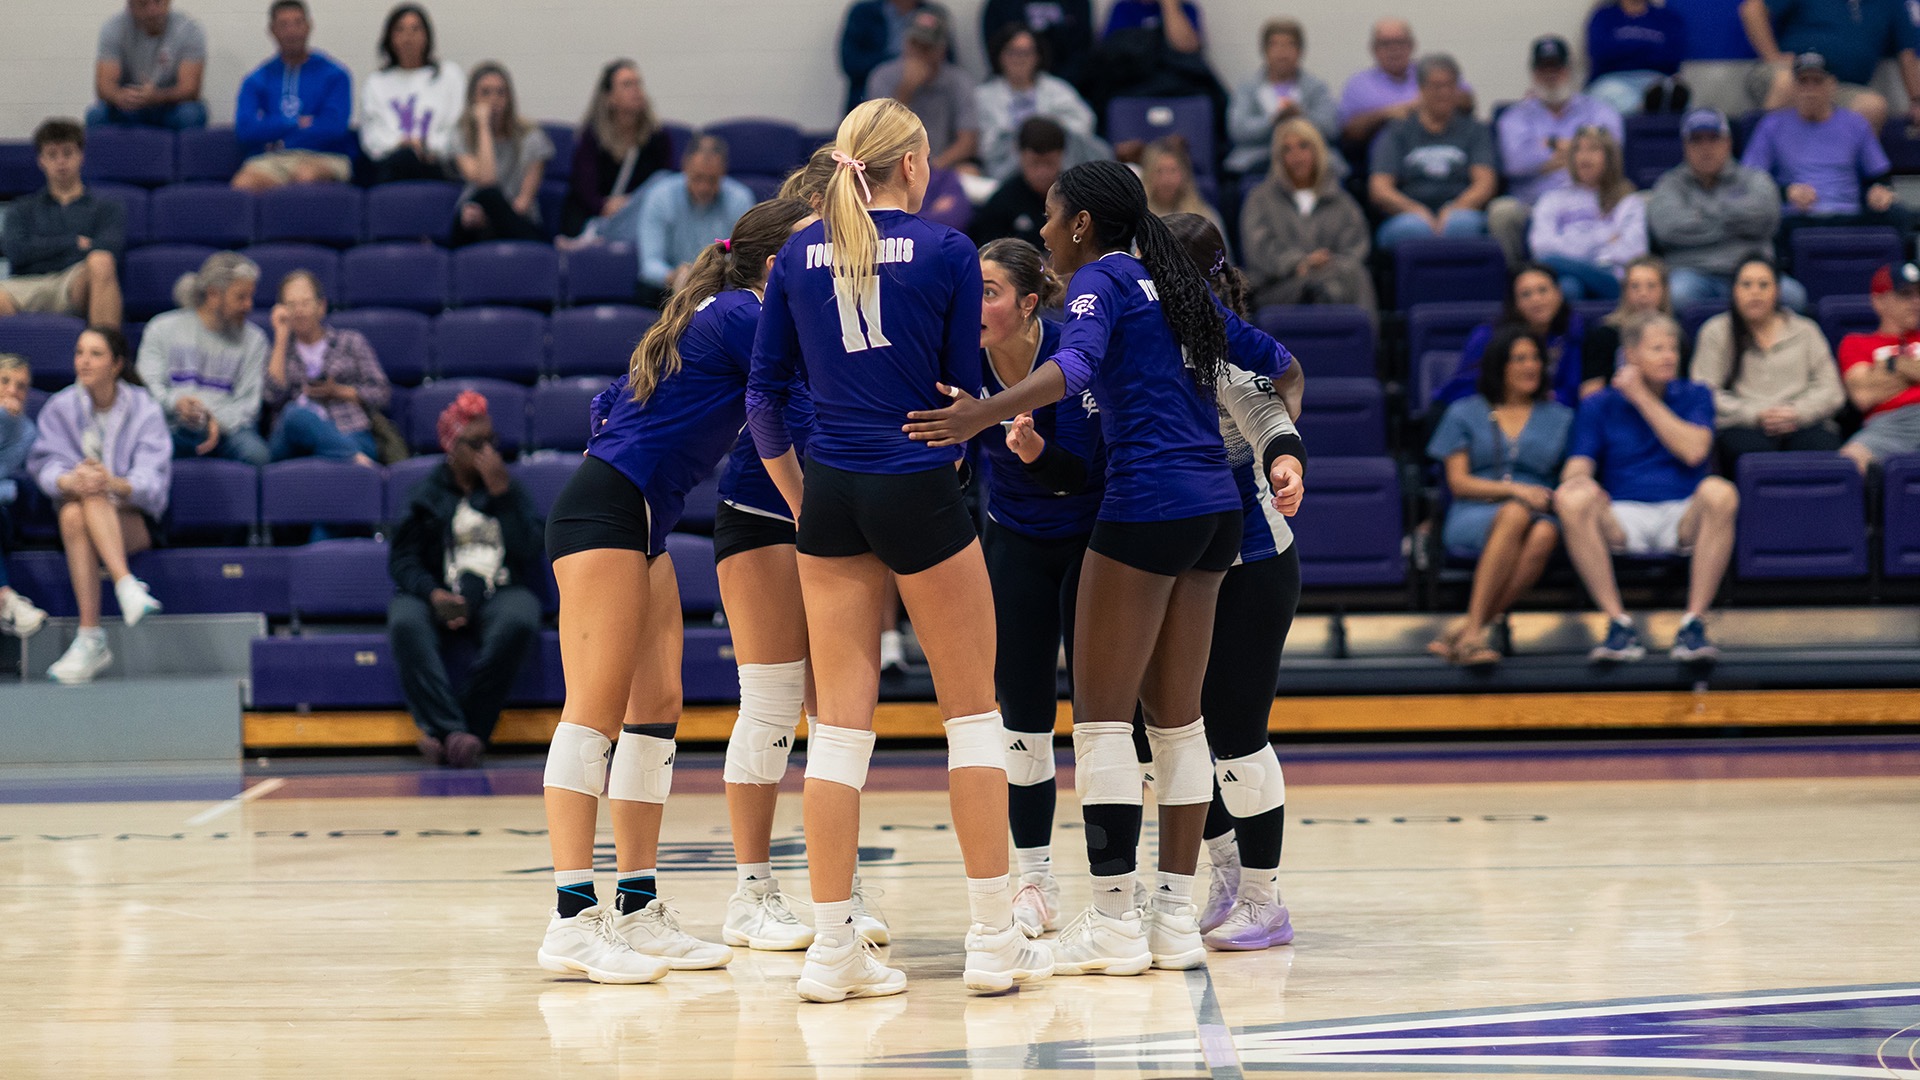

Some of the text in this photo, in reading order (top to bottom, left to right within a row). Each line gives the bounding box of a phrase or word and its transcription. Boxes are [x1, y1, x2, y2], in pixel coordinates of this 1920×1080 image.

[806, 237, 915, 270] YOU RRIS
[833, 274, 893, 353] 11
